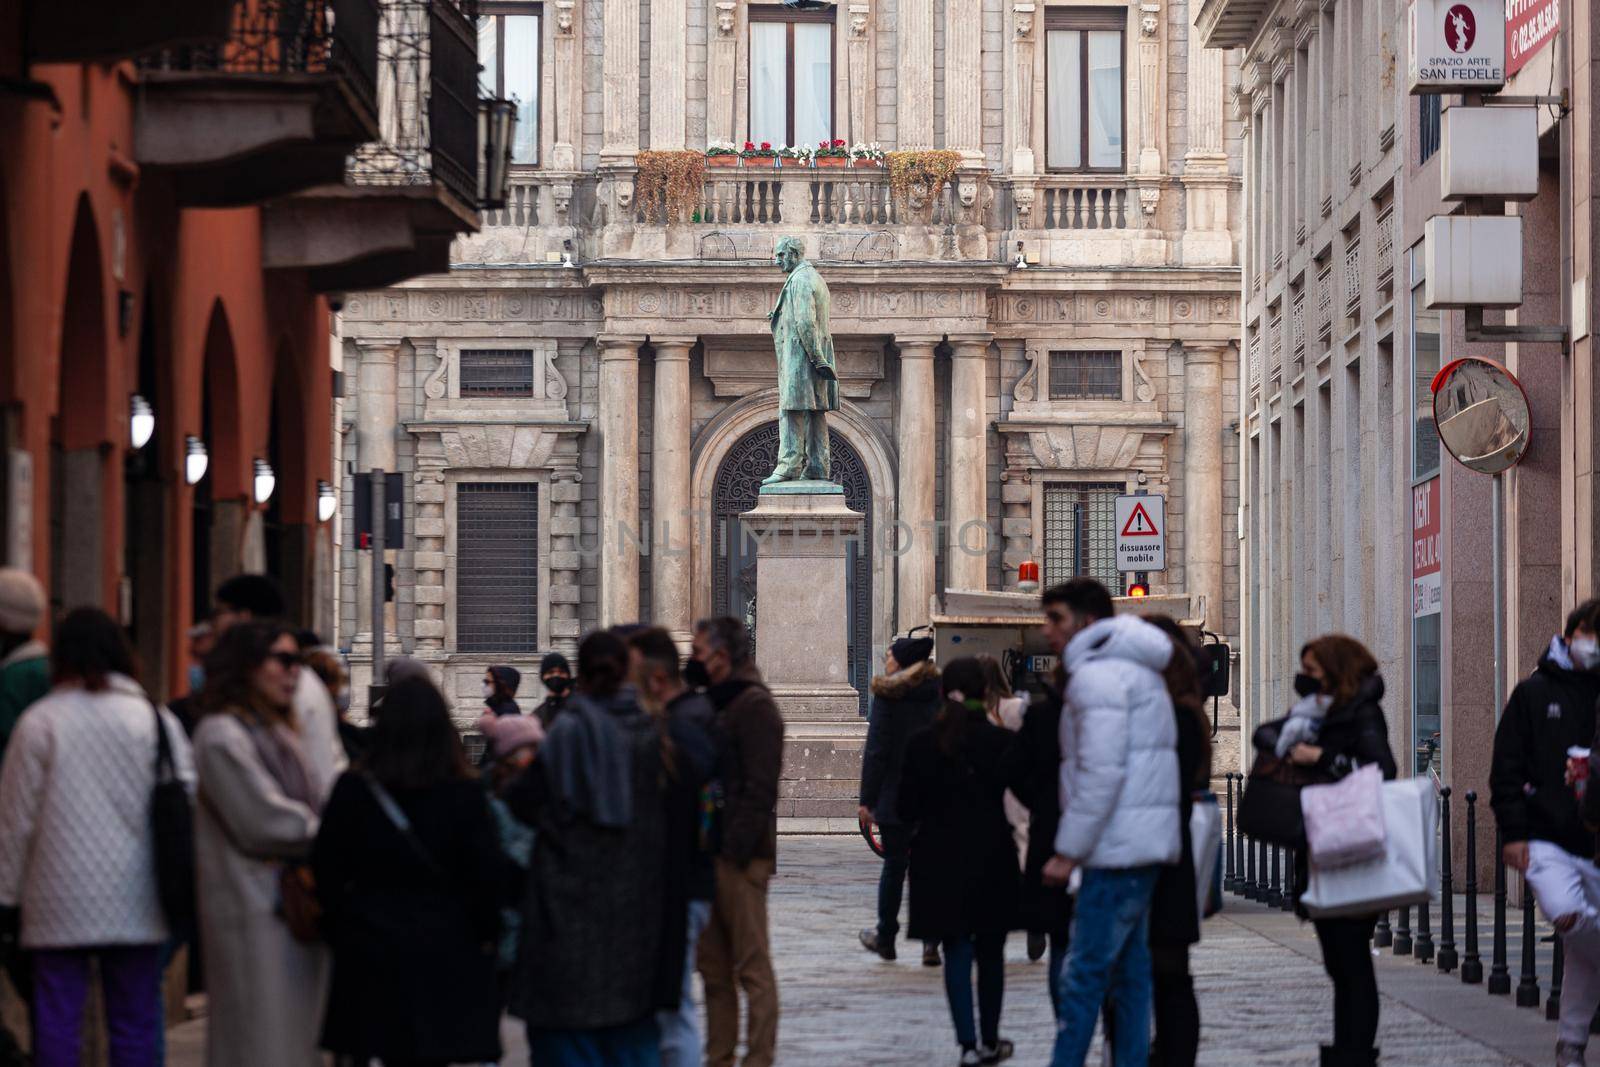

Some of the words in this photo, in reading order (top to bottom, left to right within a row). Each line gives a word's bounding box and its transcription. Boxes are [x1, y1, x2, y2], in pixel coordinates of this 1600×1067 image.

[1429, 58, 1463, 66] SPAZIO
[1467, 58, 1491, 66] ARTE
[1420, 68, 1447, 80] SAN
[1452, 68, 1500, 80] FEDELE
[1414, 481, 1431, 530] RENT
[1119, 544, 1161, 552] dissuasore
[1127, 554, 1154, 562] mobile
